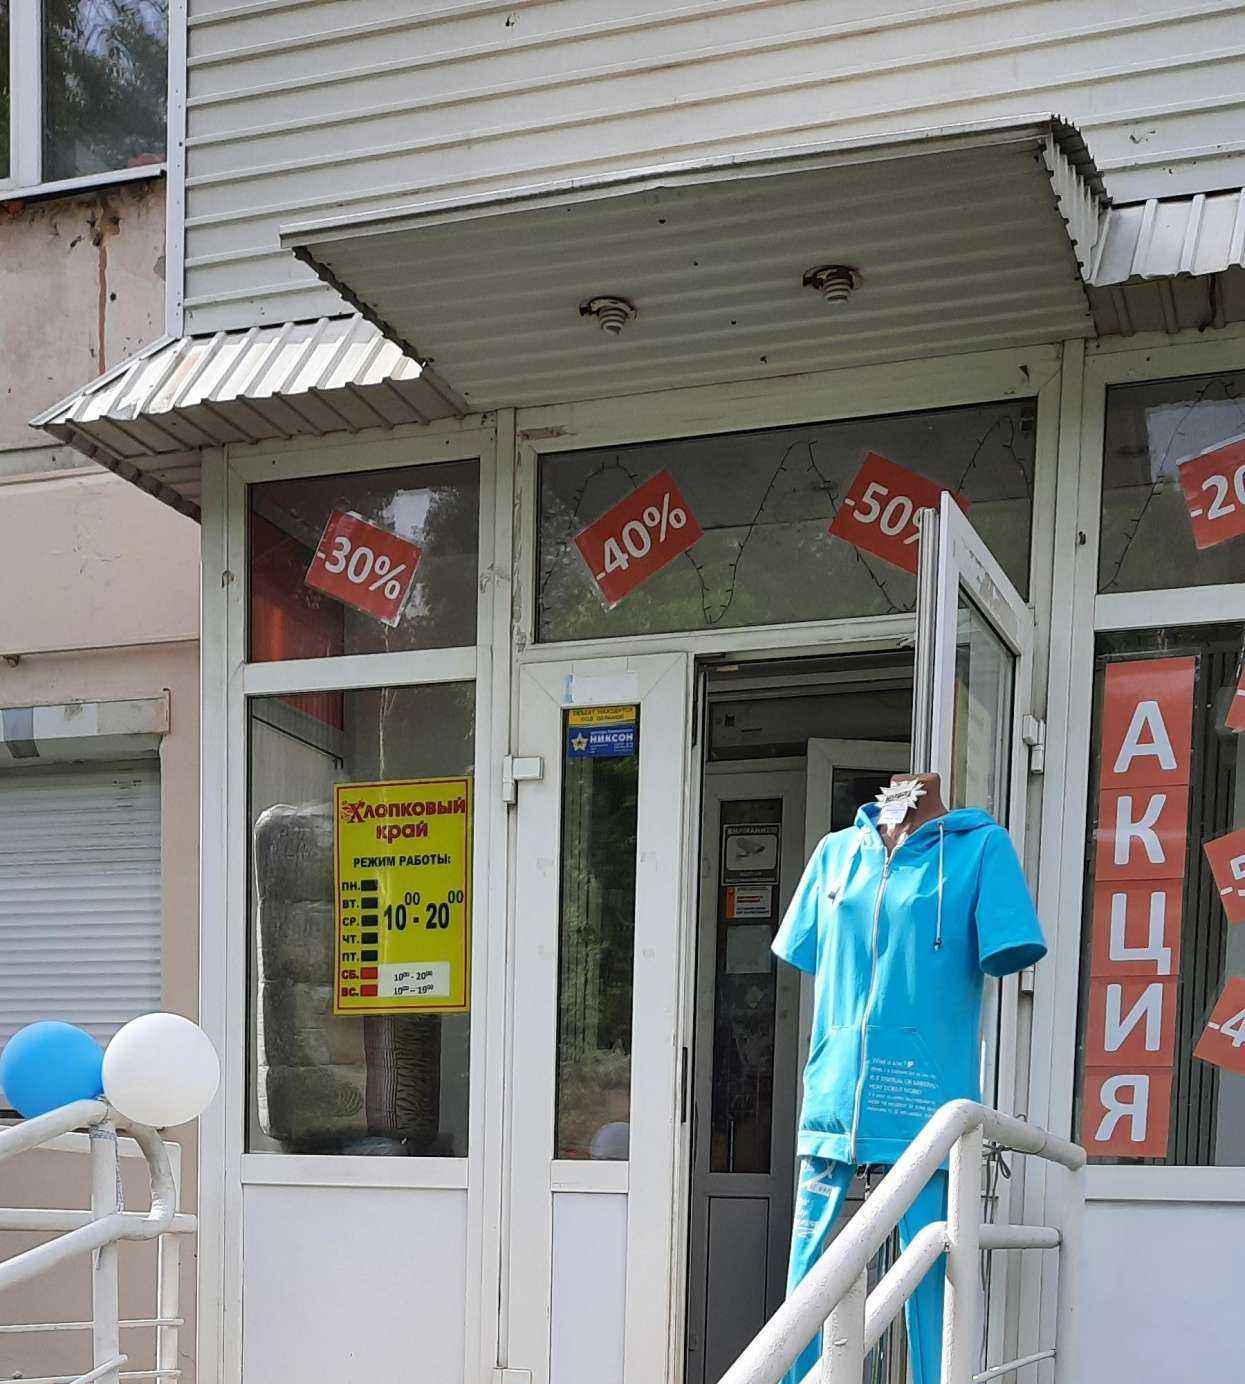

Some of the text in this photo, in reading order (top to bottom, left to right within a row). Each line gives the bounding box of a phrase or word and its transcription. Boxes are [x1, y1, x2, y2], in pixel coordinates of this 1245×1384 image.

[596, 492, 687, 580] -40%
[316, 536, 401, 600] -30%
[590, 732, 634, 744] НИКСОН
[376, 820, 428, 844] край
[353, 853, 452, 868] РЕЖИМ РАБОТЫ:
